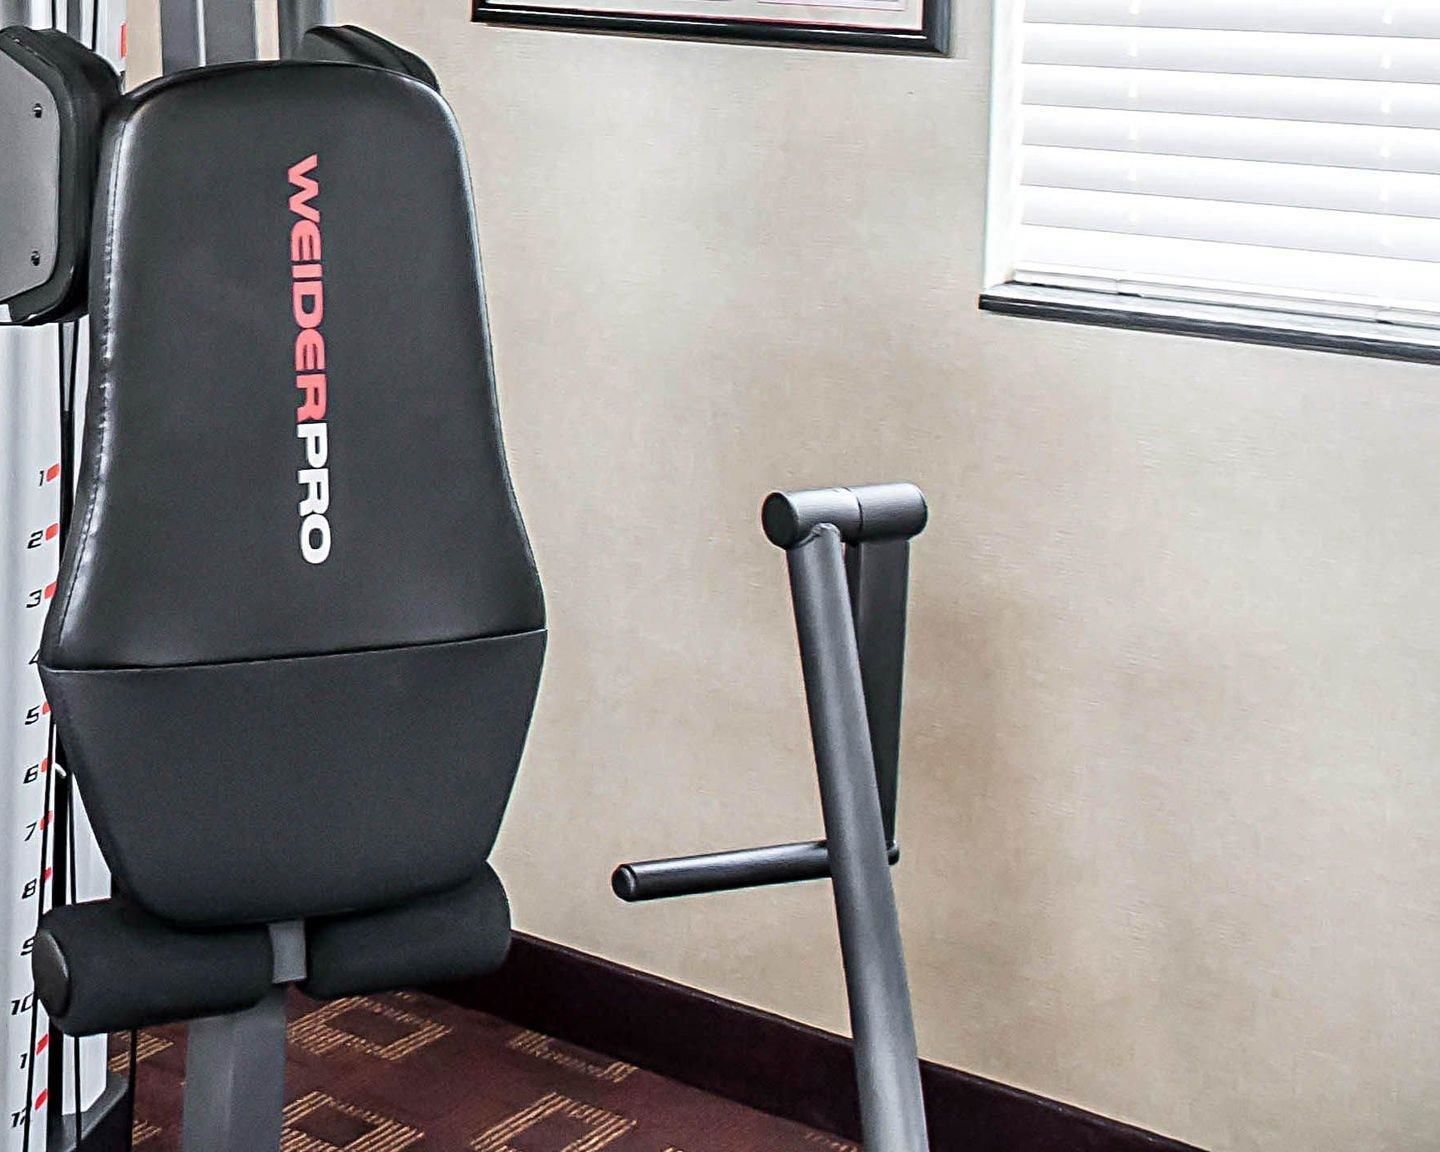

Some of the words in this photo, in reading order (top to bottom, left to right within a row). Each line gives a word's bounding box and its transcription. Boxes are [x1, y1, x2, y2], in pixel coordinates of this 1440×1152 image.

[39, 470, 45, 487] 1
[27, 531, 43, 549] 2
[26, 590, 42, 609] 3
[25, 705, 40, 725] 5
[23, 765, 38, 784] 6
[24, 823, 37, 842] 7
[22, 879, 37, 899] 8
